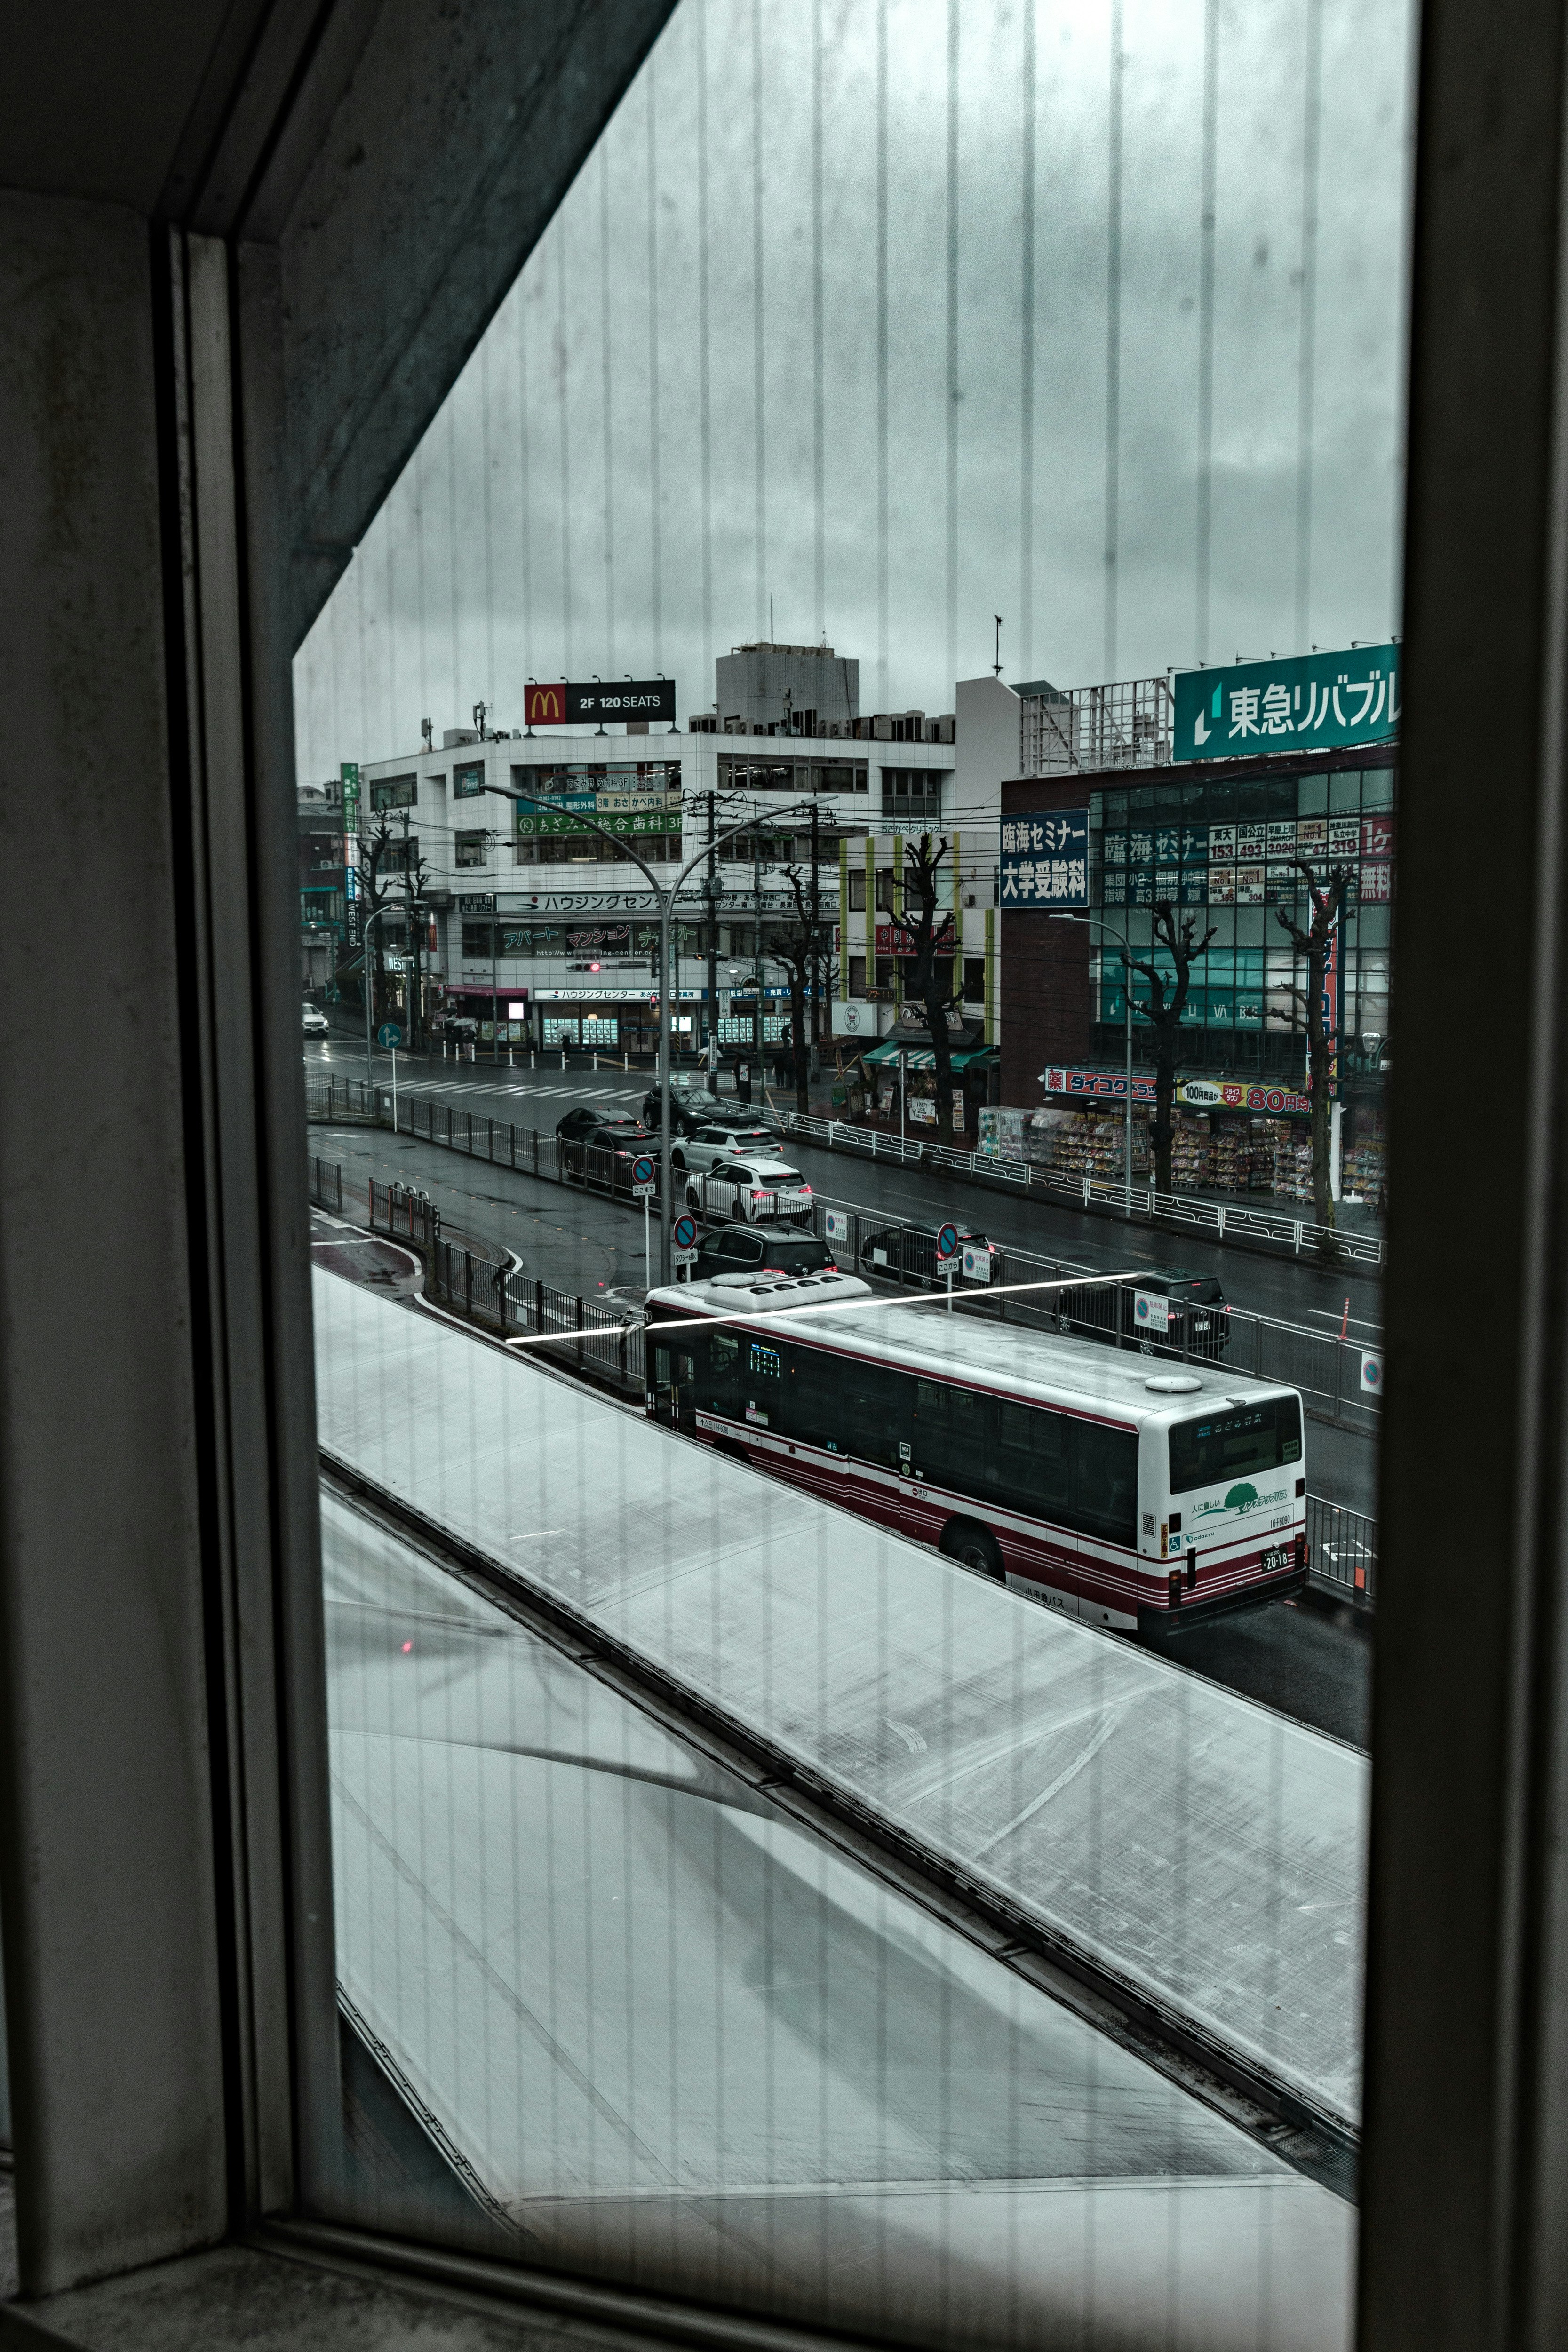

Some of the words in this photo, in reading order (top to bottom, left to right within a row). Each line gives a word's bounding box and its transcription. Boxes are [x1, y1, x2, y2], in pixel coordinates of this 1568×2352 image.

[580, 698, 595, 708] 2F
[600, 697, 621, 708] 120
[623, 696, 660, 707] SEATS
[1228, 670, 1402, 739] 東急リバブル
[567, 777, 594, 789] あざみ野
[566, 801, 595, 810] 整形外科
[598, 798, 609, 808] 3階
[1003, 820, 1085, 853] 臨海セミナー
[1214, 829, 1232, 841] 東大
[1239, 825, 1265, 839] 国公立
[1268, 825, 1295, 835] 早慶上理
[1333, 830, 1357, 838] 私立中学
[1105, 830, 1207, 863] 臨海セミナー
[1003, 858, 1085, 899] 大学受験科
[1105, 873, 1126, 887] 集団
[1105, 888, 1126, 903] 指導
[1136, 889, 1152, 903] 高3
[1155, 887, 1178, 902] 指導
[504, 926, 559, 948] アパート
[567, 925, 630, 947] マンション
[562, 990, 635, 999] ハウジングセンター
[1048, 1069, 1063, 1091] 薬
[1070, 1075, 1157, 1097] ダイコクドラッ
[1186, 1086, 1218, 1101] 100円商品が
[1247, 1086, 1313, 1113] 80円均
[675, 1252, 697, 1263] タクシーを除く
[939, 1262, 957, 1271] ここから
[1150, 1301, 1167, 1311] 駐車禁止
[1192, 1499, 1220, 1513] 人に優しい
[1242, 1489, 1288, 1511] ノンステップバス
[1271, 1514, 1290, 1528] 16-F6090
[1266, 1553, 1287, 1569] 20-18
[1026, 1587, 1064, 1609] 小田急バス
